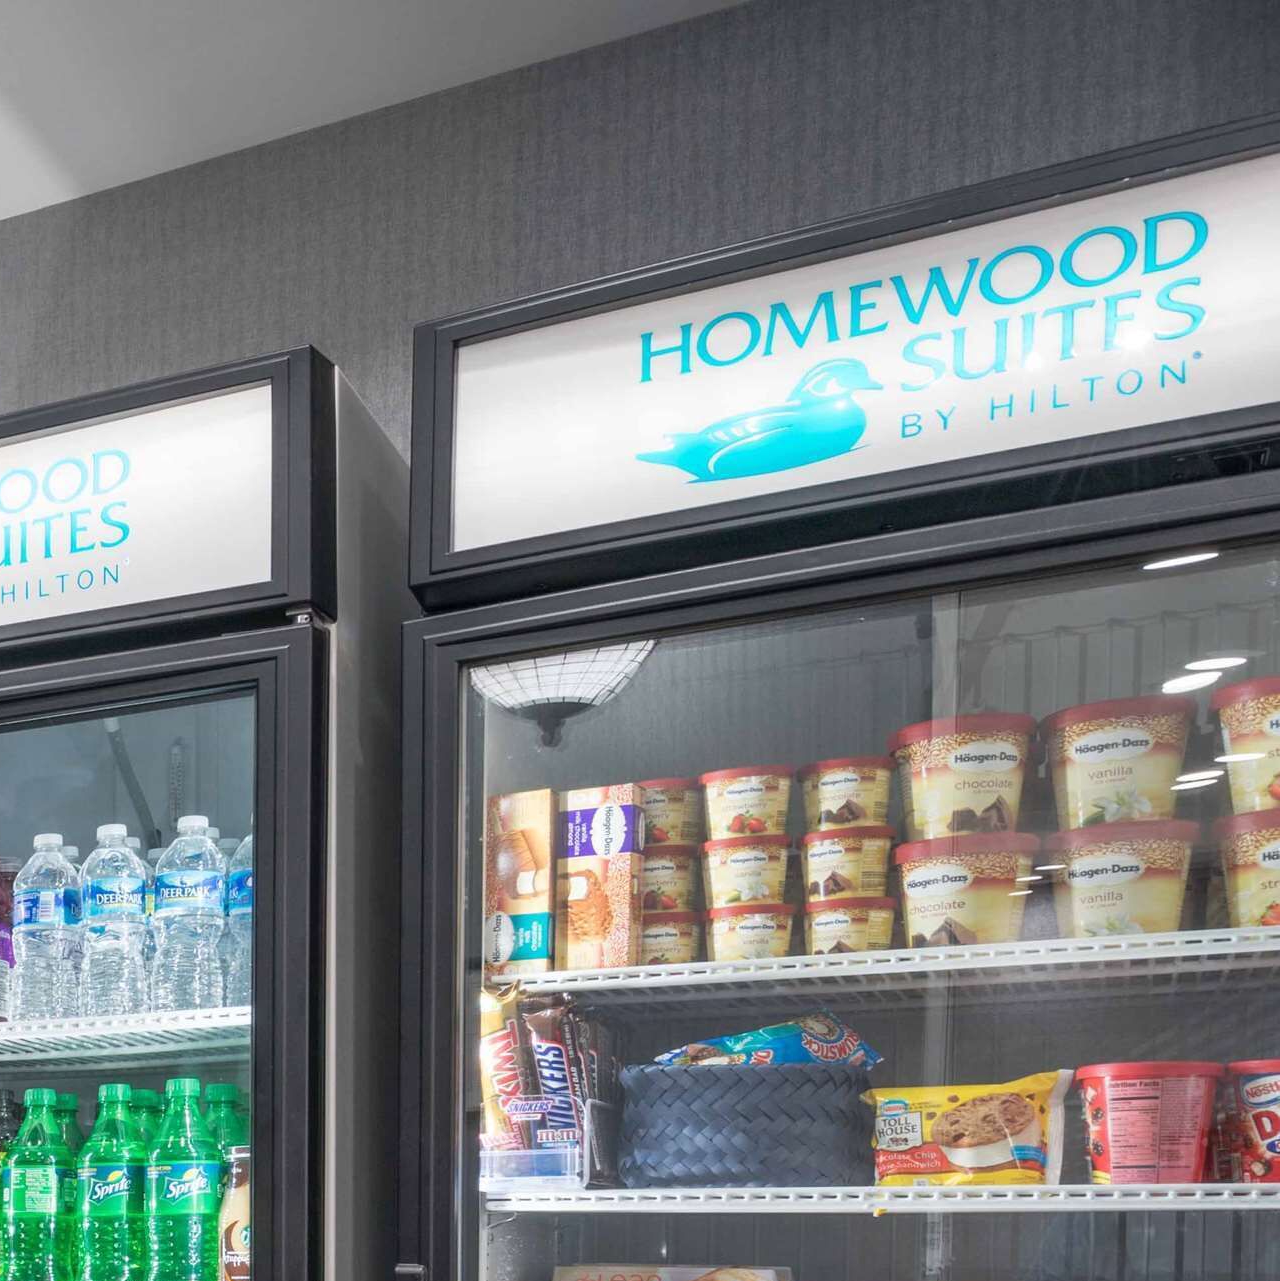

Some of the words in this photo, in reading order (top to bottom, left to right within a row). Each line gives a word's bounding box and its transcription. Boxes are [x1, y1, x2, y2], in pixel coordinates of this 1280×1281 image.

[640, 210, 1209, 384] HOMEWOOD
[900, 278, 1208, 390] SUITES
[900, 406, 957, 440] BY
[990, 359, 1188, 422] HILTON
[1, 564, 122, 605] HILTON
[1074, 737, 1150, 756] Häagen-Dazs
[1088, 765, 1134, 781] vanilla
[954, 777, 1014, 792] chocolate
[96, 894, 121, 905] DEER
[160, 887, 186, 899] DEER
[1079, 890, 1124, 906] vanilla
[489, 1020, 522, 1109] TWIX
[507, 1101, 550, 1112] SNICKERS
[881, 1117, 912, 1127] TOLL
[878, 1125, 918, 1138] HOUSE
[896, 1160, 941, 1169] Sandwich
[93, 1177, 131, 1199] Sprite
[165, 1176, 209, 1199] Sprite
